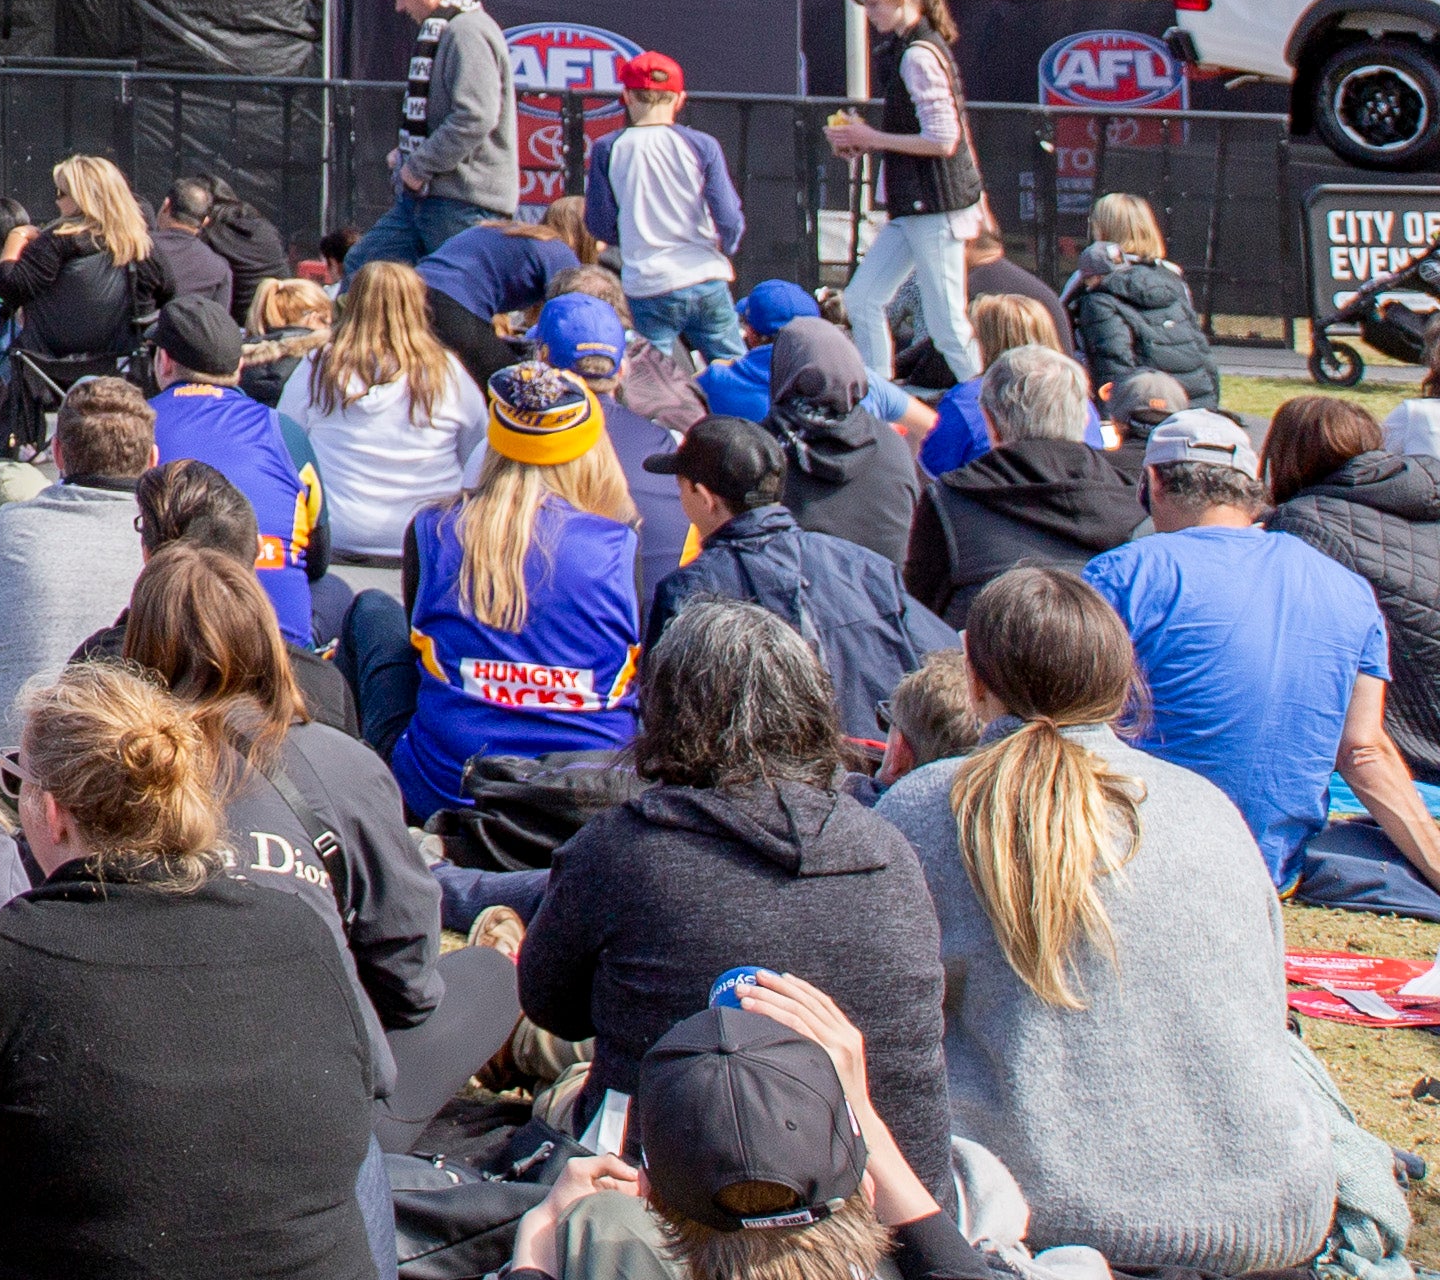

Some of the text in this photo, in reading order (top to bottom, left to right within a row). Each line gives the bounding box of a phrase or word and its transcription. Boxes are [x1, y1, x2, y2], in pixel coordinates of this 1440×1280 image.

[509, 45, 625, 91] AFL
[1054, 48, 1173, 90] AFL
[1327, 210, 1440, 245] CITY OF
[1330, 246, 1428, 280] EVEN
[474, 661, 580, 689] HUNGRY
[249, 832, 330, 889] Dior
